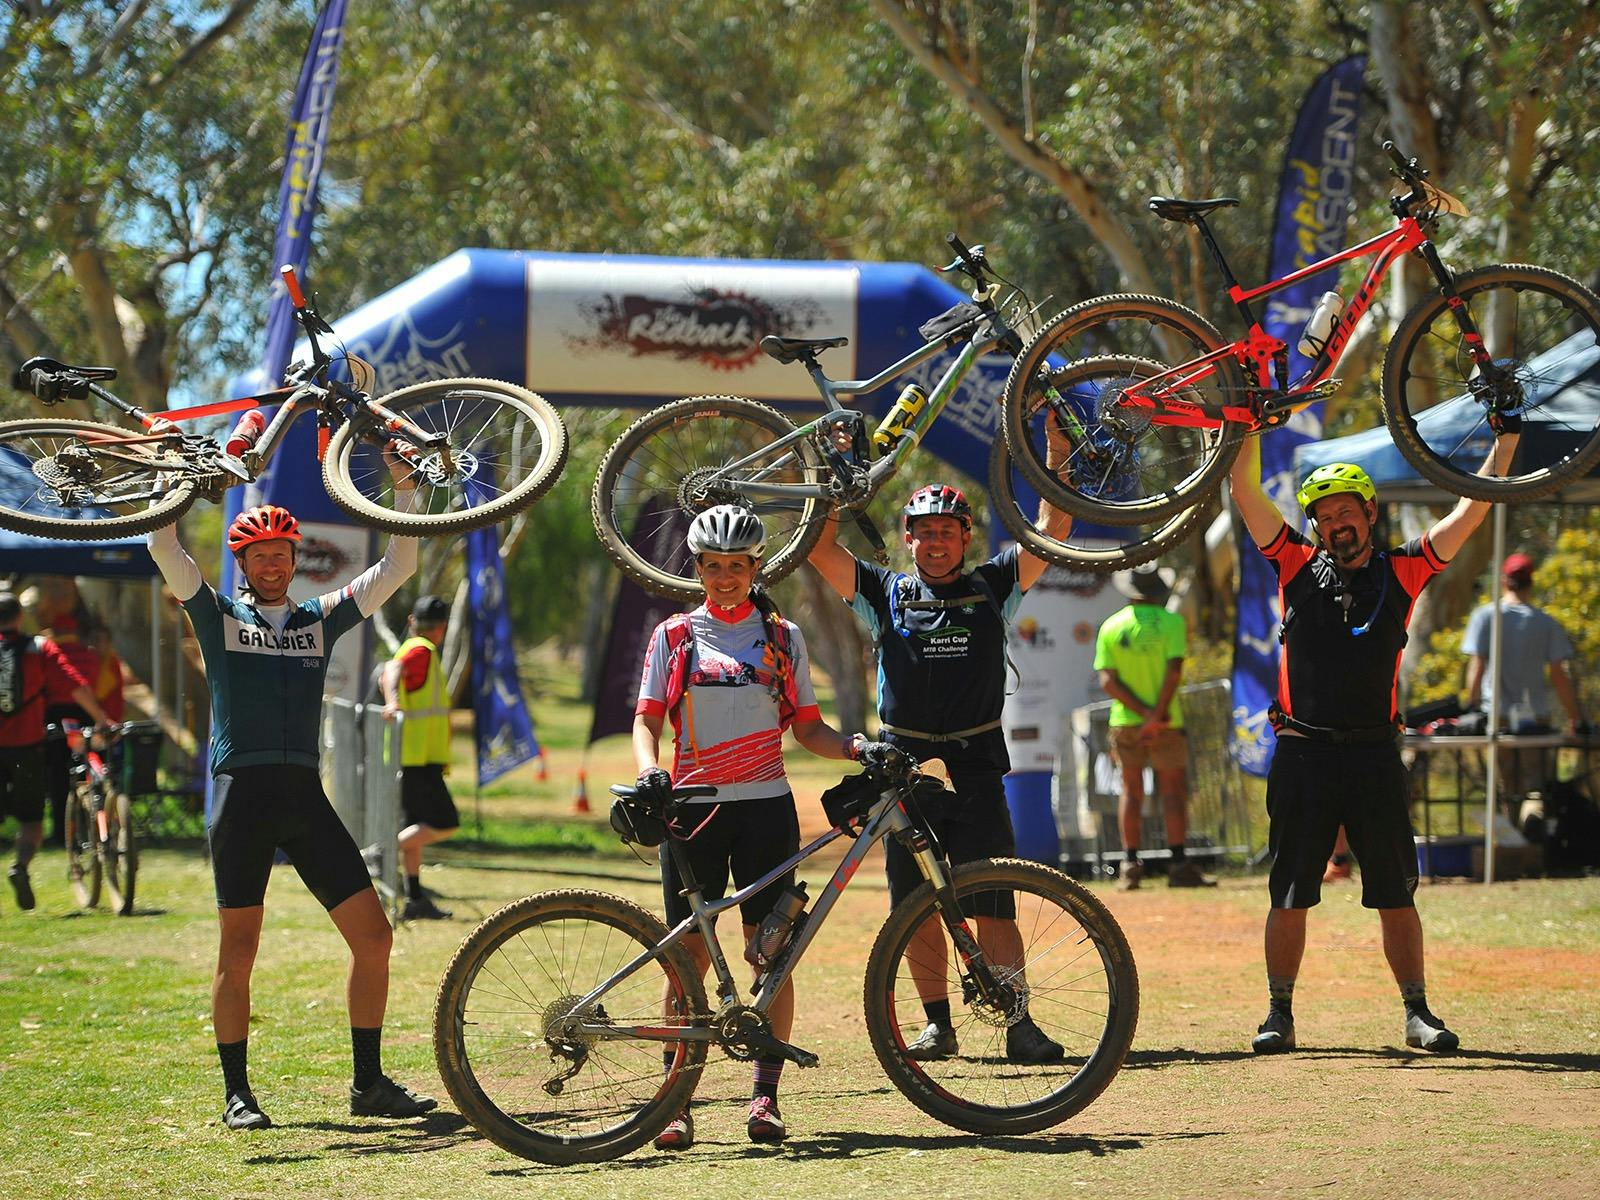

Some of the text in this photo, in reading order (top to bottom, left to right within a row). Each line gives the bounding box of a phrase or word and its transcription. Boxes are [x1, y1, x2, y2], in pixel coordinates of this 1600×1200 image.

[628, 310, 758, 346] Redback
[930, 635, 968, 644] Karri Cup
